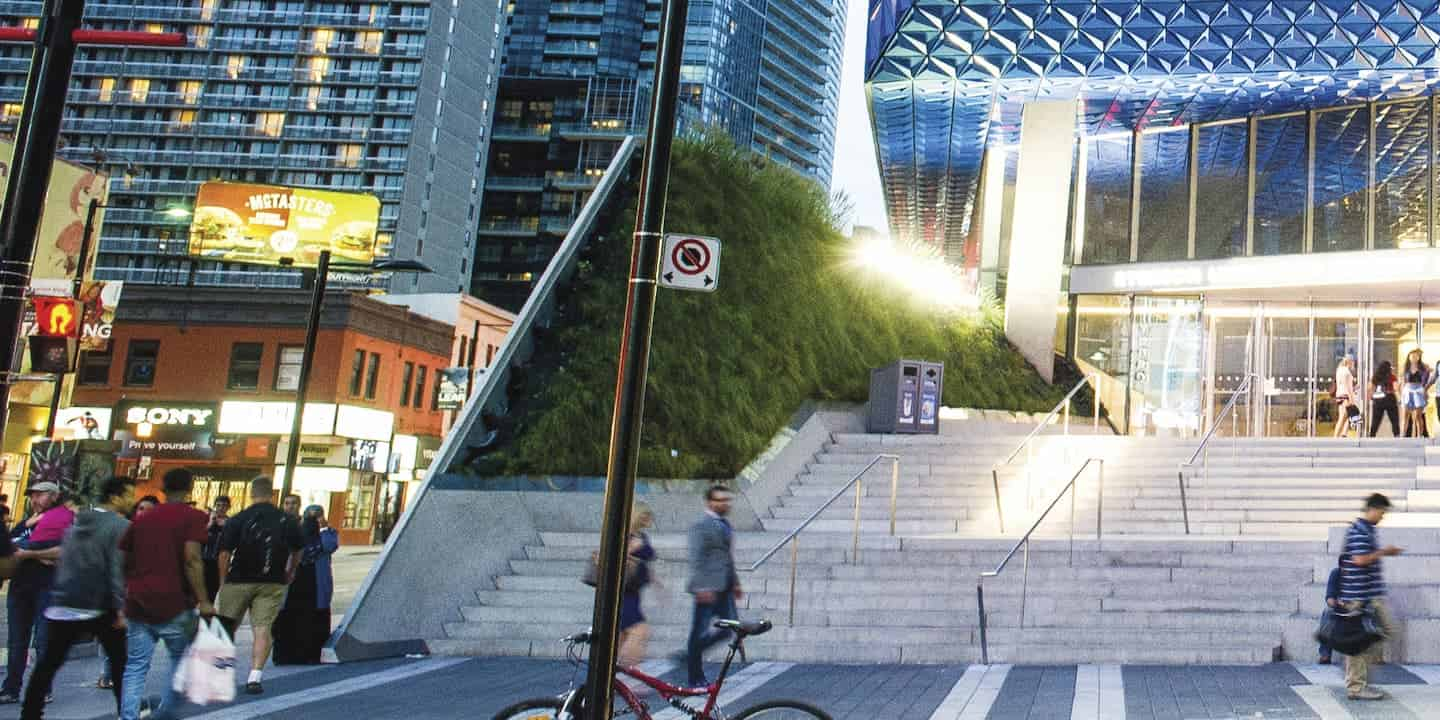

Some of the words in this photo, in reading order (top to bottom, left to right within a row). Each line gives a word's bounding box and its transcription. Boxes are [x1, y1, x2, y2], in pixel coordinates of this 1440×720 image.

[127, 407, 212, 425] SONY
[128, 440, 155, 449] Prve
[158, 440, 196, 450] yourself
